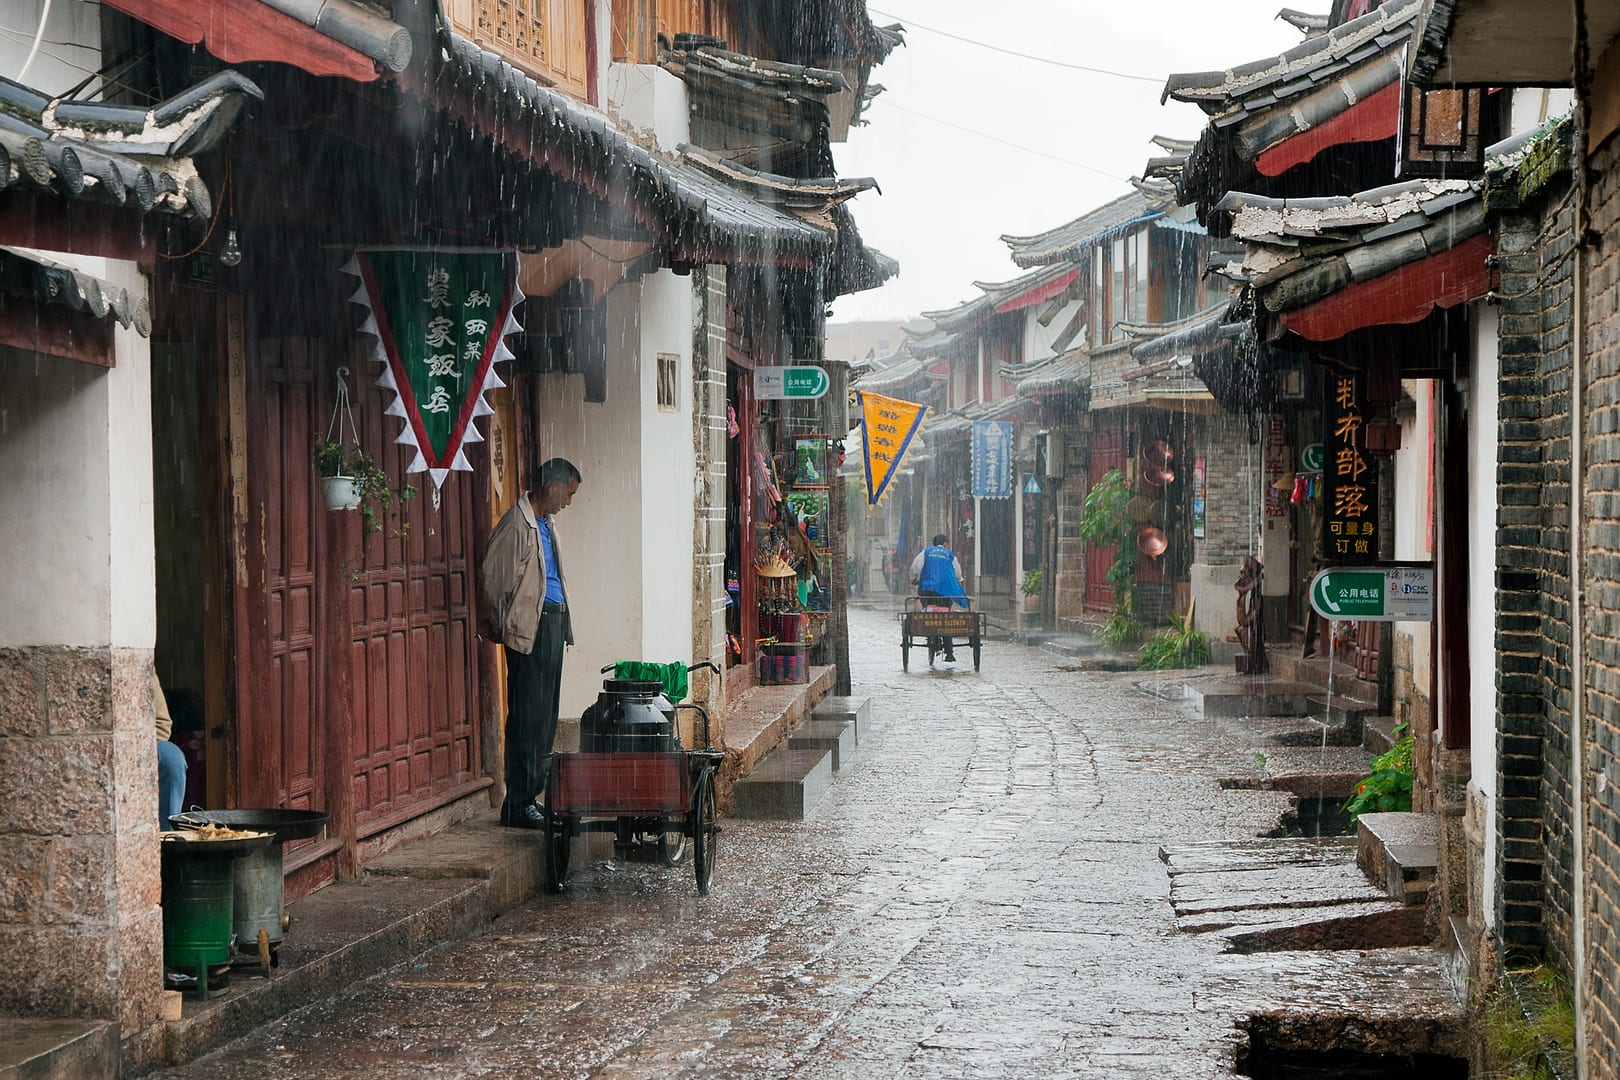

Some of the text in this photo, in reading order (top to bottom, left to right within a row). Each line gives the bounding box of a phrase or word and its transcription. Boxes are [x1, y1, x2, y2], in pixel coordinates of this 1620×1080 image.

[463, 289, 491, 362] 納西菜
[1329, 521, 1374, 537] 可量身
[1336, 538, 1369, 554] 订做
[1339, 588, 1379, 599] 公用电话
